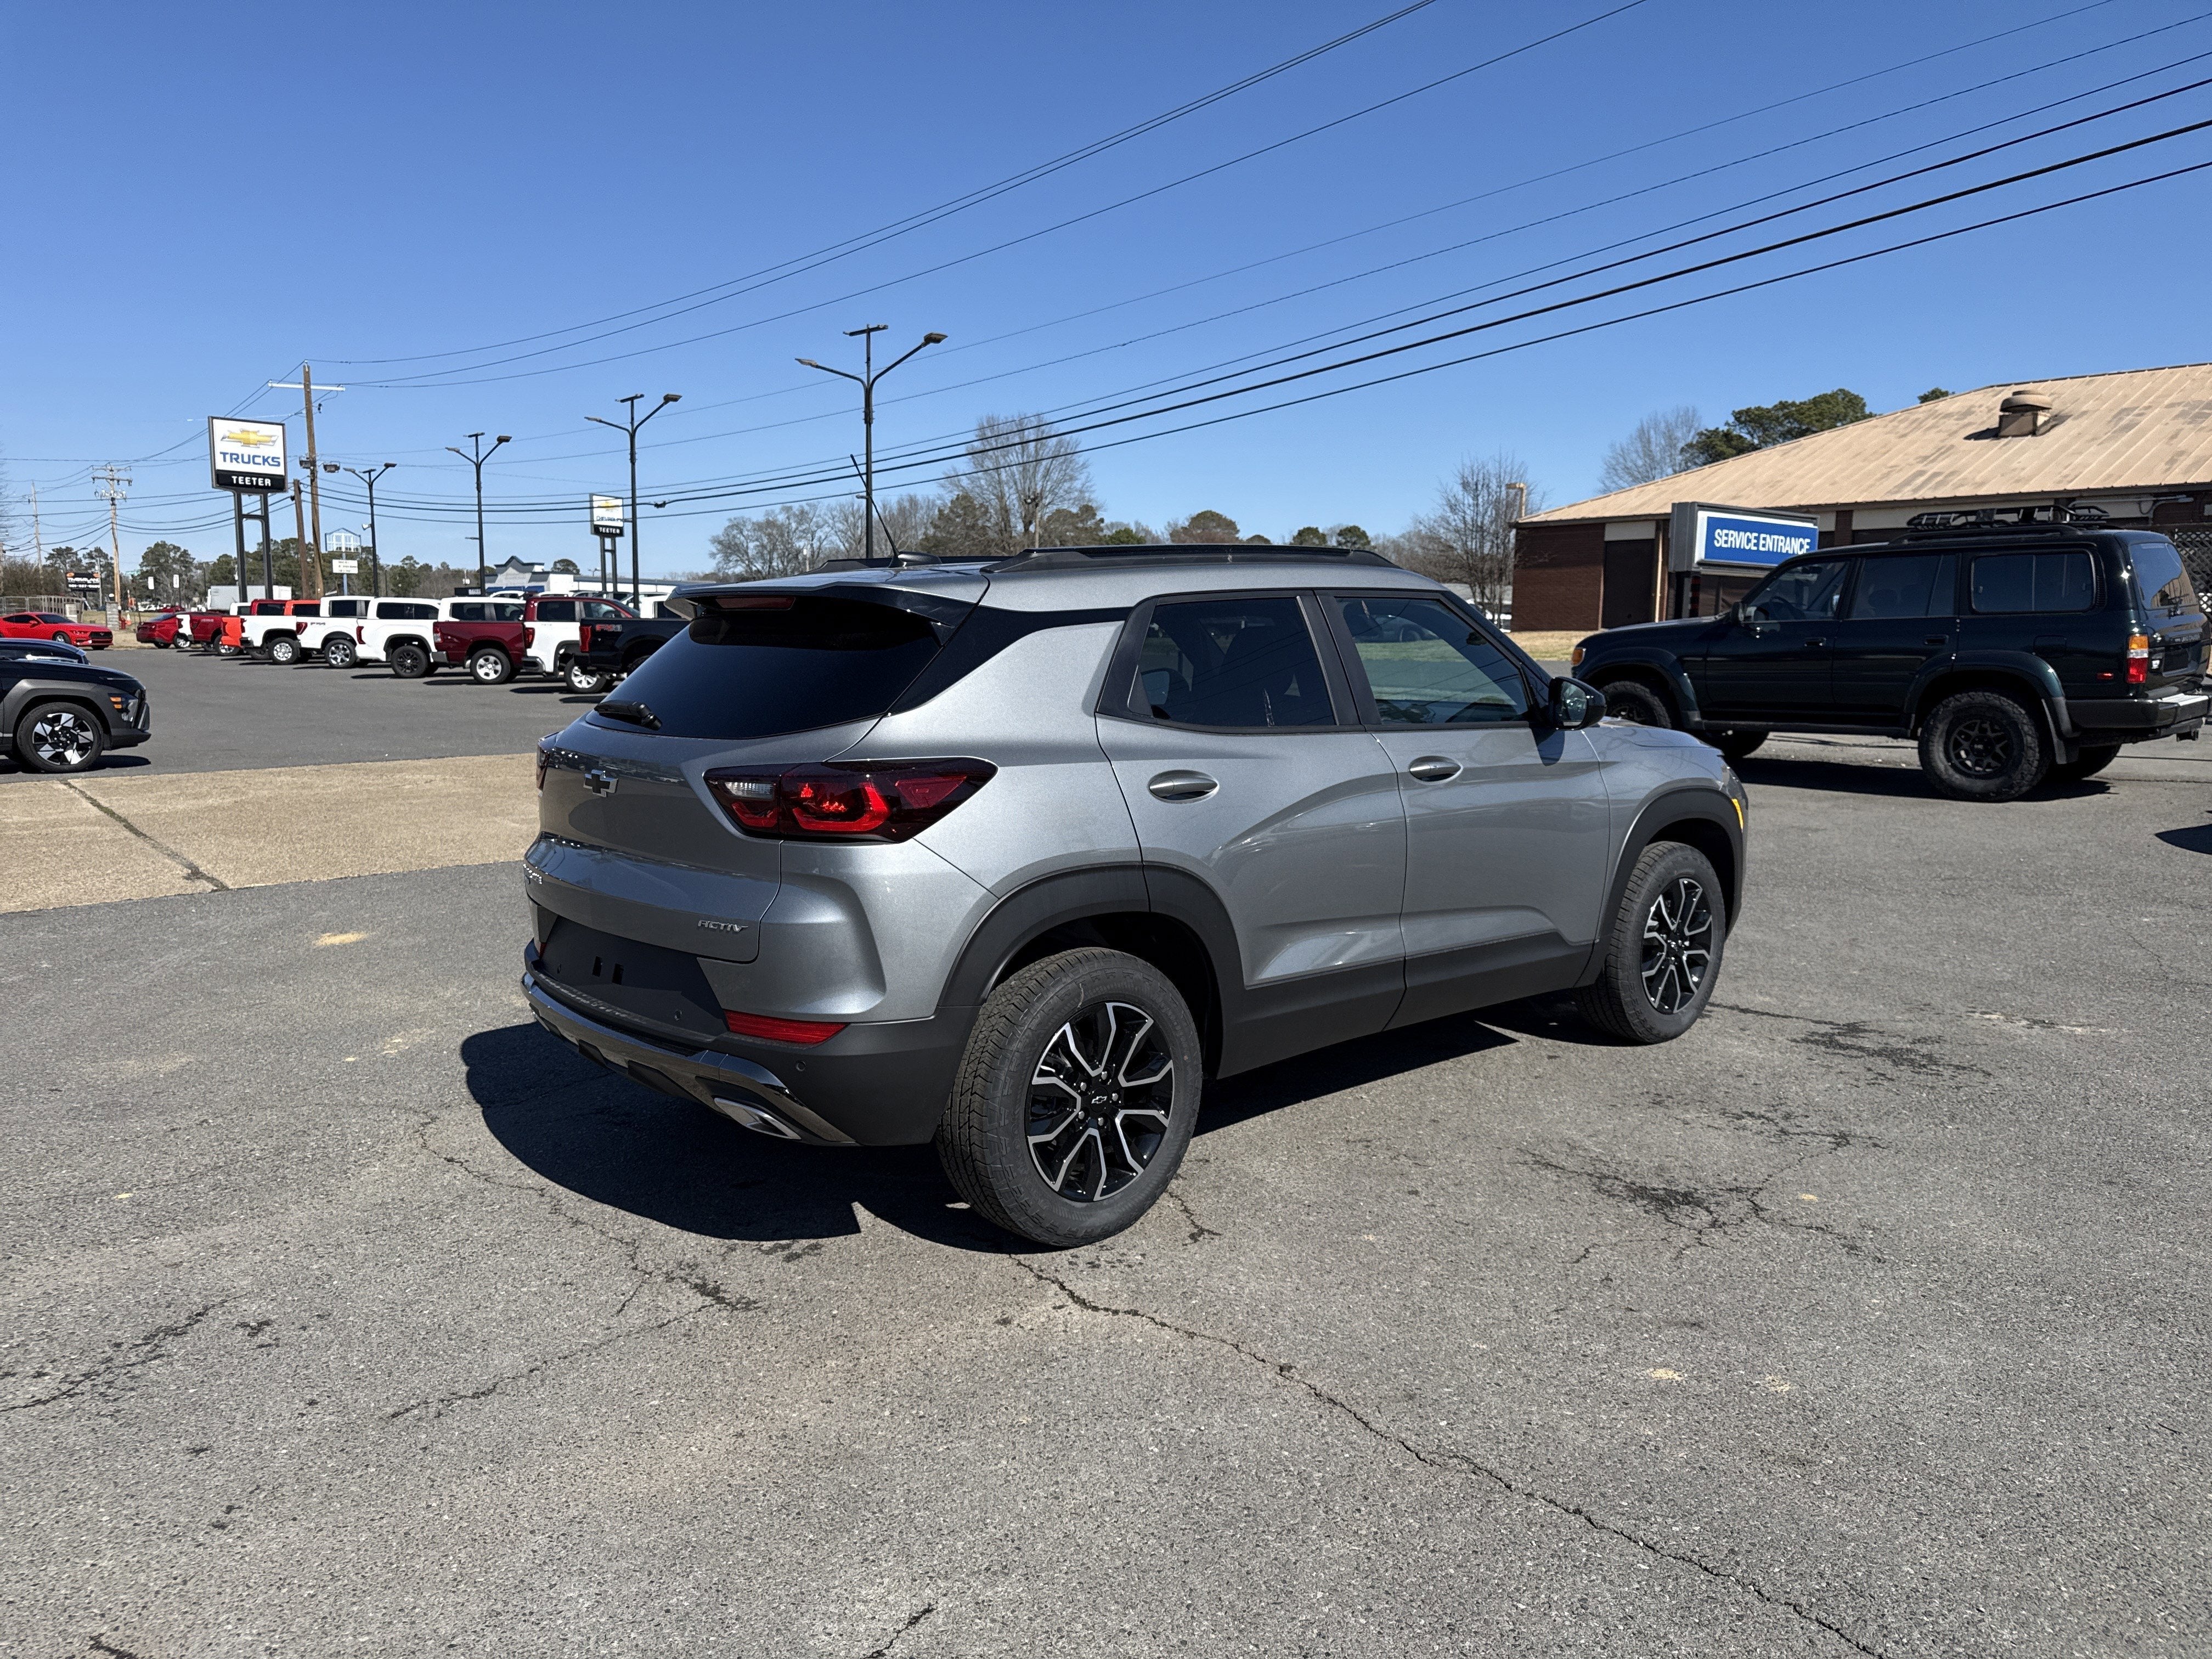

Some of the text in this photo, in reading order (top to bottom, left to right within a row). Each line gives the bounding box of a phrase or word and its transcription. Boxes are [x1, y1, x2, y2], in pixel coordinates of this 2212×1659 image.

[219, 452, 280, 467] TRUCKS
[232, 476, 272, 487] TEETER
[1714, 528, 1811, 555] SERVICE ENTRANCE
[698, 919, 748, 932] ACTIV
